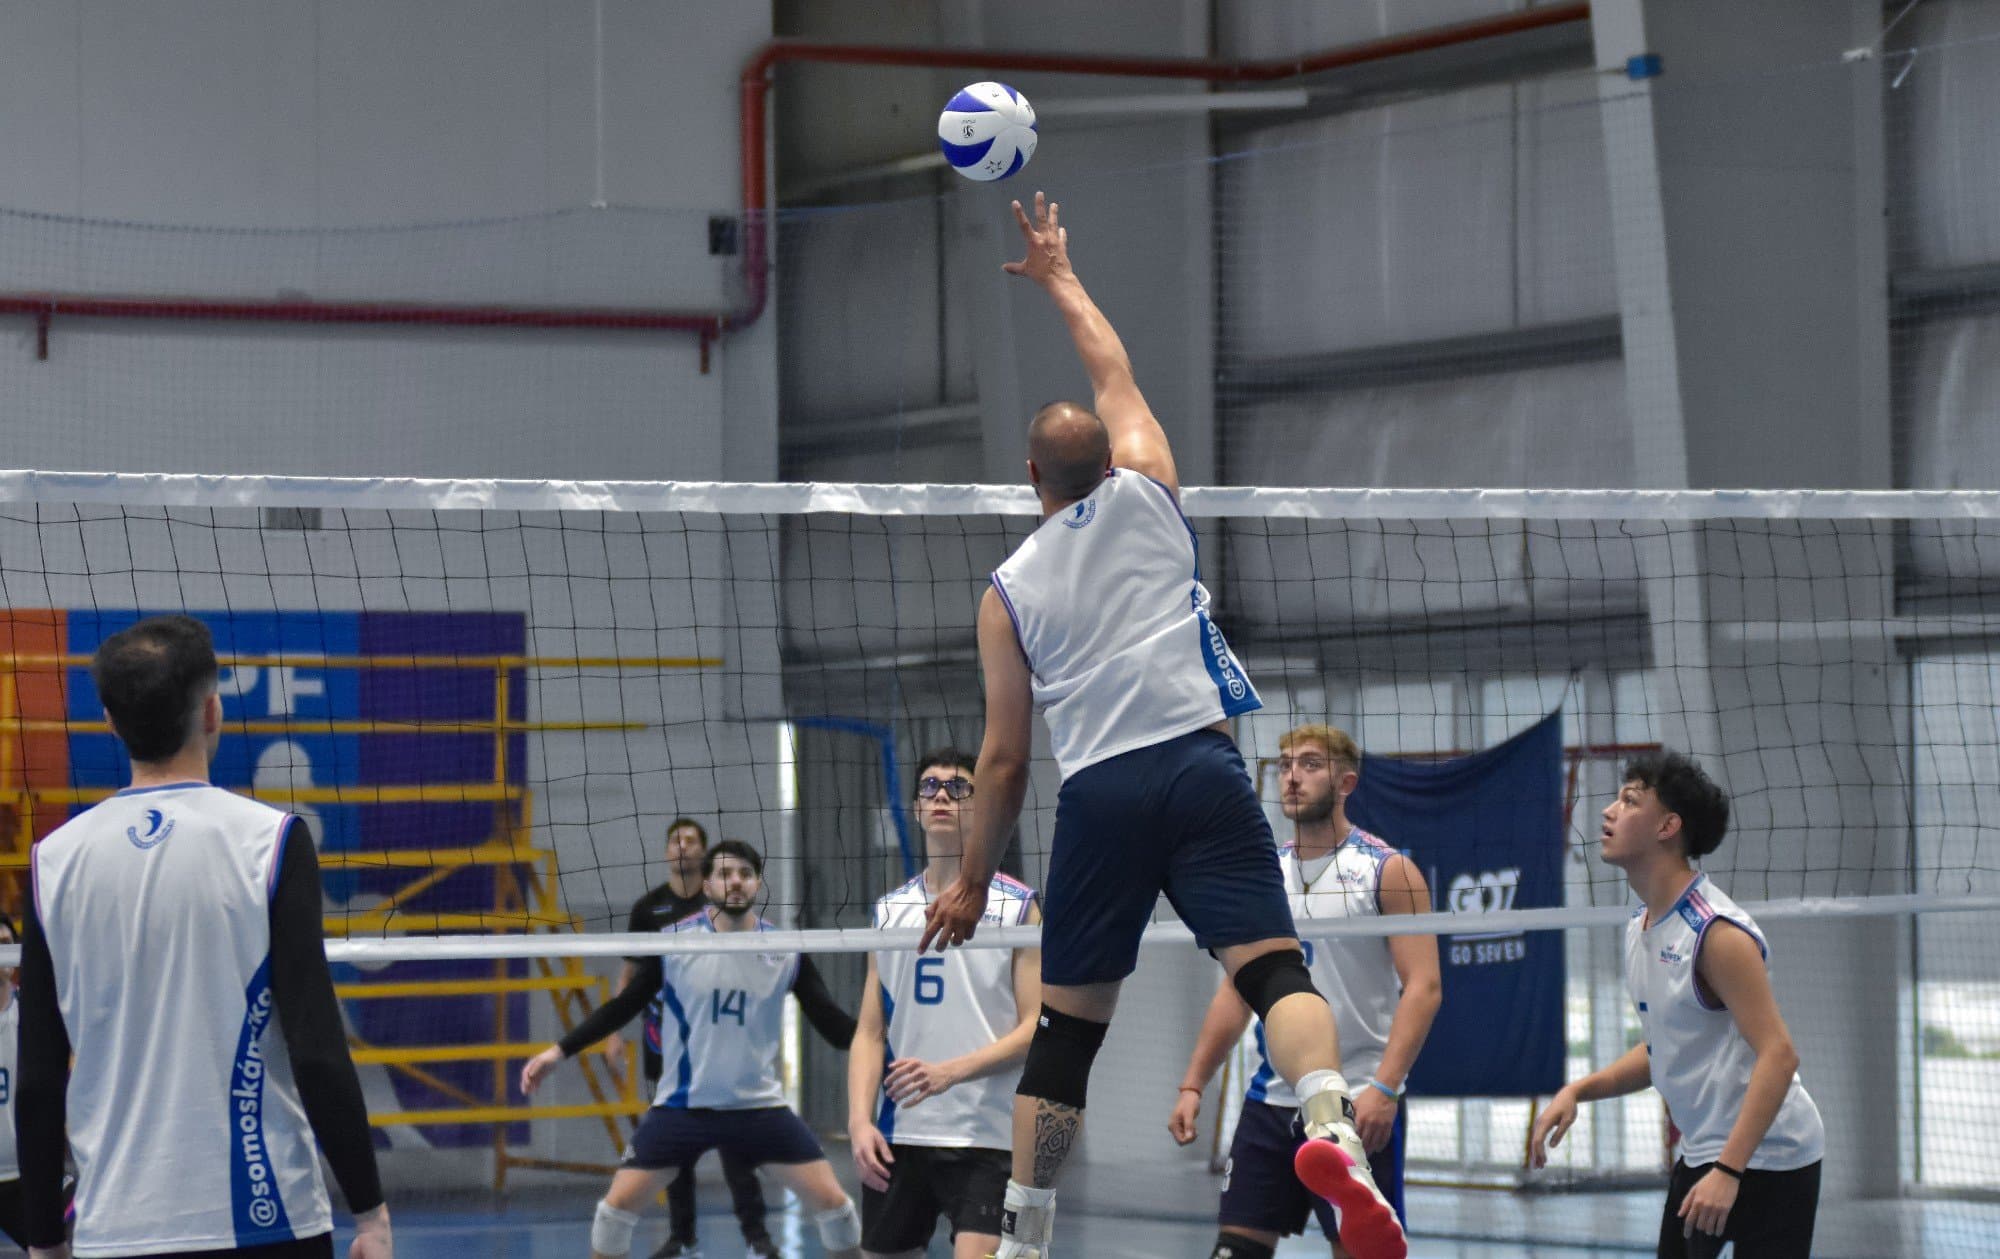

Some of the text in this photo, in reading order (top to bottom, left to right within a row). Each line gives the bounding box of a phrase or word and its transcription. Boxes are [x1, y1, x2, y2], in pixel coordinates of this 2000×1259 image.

[1451, 939, 1525, 965] GO SEVEN
[915, 957, 945, 1006] 6
[711, 988, 747, 1026] 14
